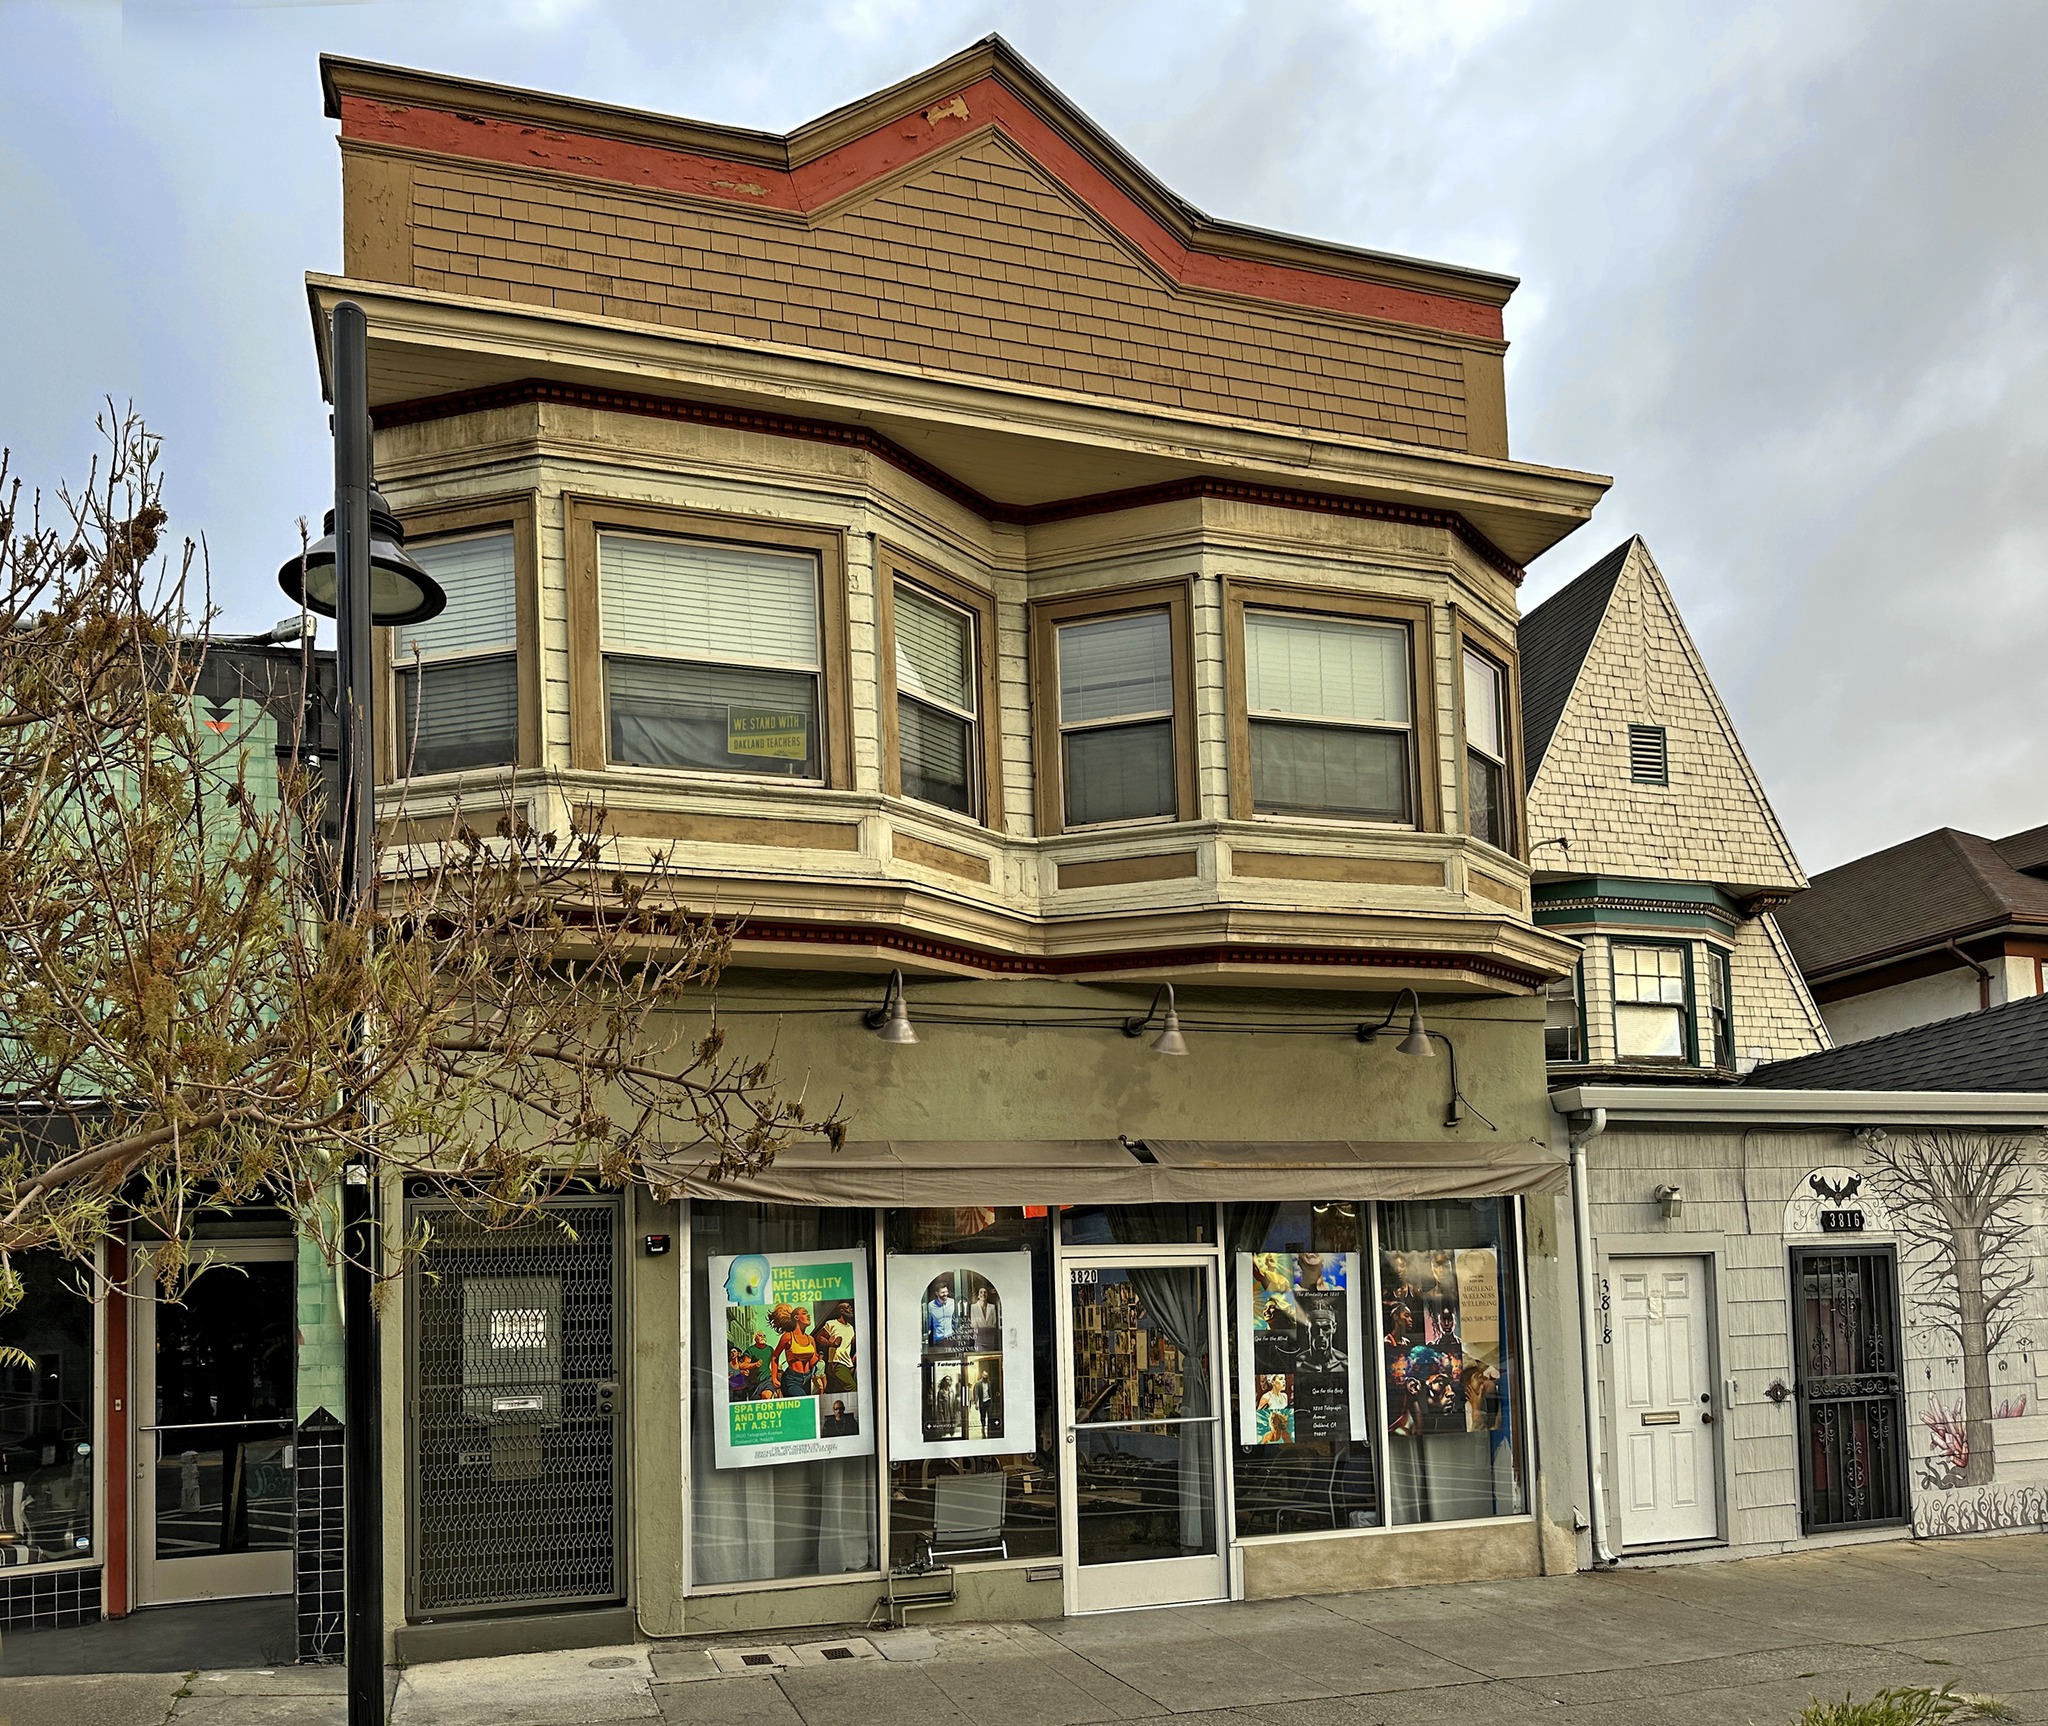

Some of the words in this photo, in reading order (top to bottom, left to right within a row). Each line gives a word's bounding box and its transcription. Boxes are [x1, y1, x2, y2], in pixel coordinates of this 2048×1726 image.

[733, 718, 747, 731] WE
[750, 716, 776, 730] STAND
[778, 715, 799, 728] WITH
[733, 738, 765, 750] OAKLAND
[766, 736, 801, 748] TEACHERS
[1829, 1212, 1860, 1228] 3816
[771, 1267, 796, 1280] THE
[1070, 1270, 1097, 1283] 3820
[772, 1276, 842, 1292] MENTALITY
[773, 1291, 789, 1304] AT
[791, 1290, 823, 1303] 3820
[1601, 1279, 1613, 1344] 3818
[734, 1404, 753, 1414] SPA
[755, 1402, 774, 1412] FOR
[775, 1400, 801, 1410] MIND
[734, 1413, 754, 1423] AND
[756, 1410, 782, 1420] BODY
[734, 1422, 747, 1432] AT
[751, 1419, 782, 1430] A.S.T.I
